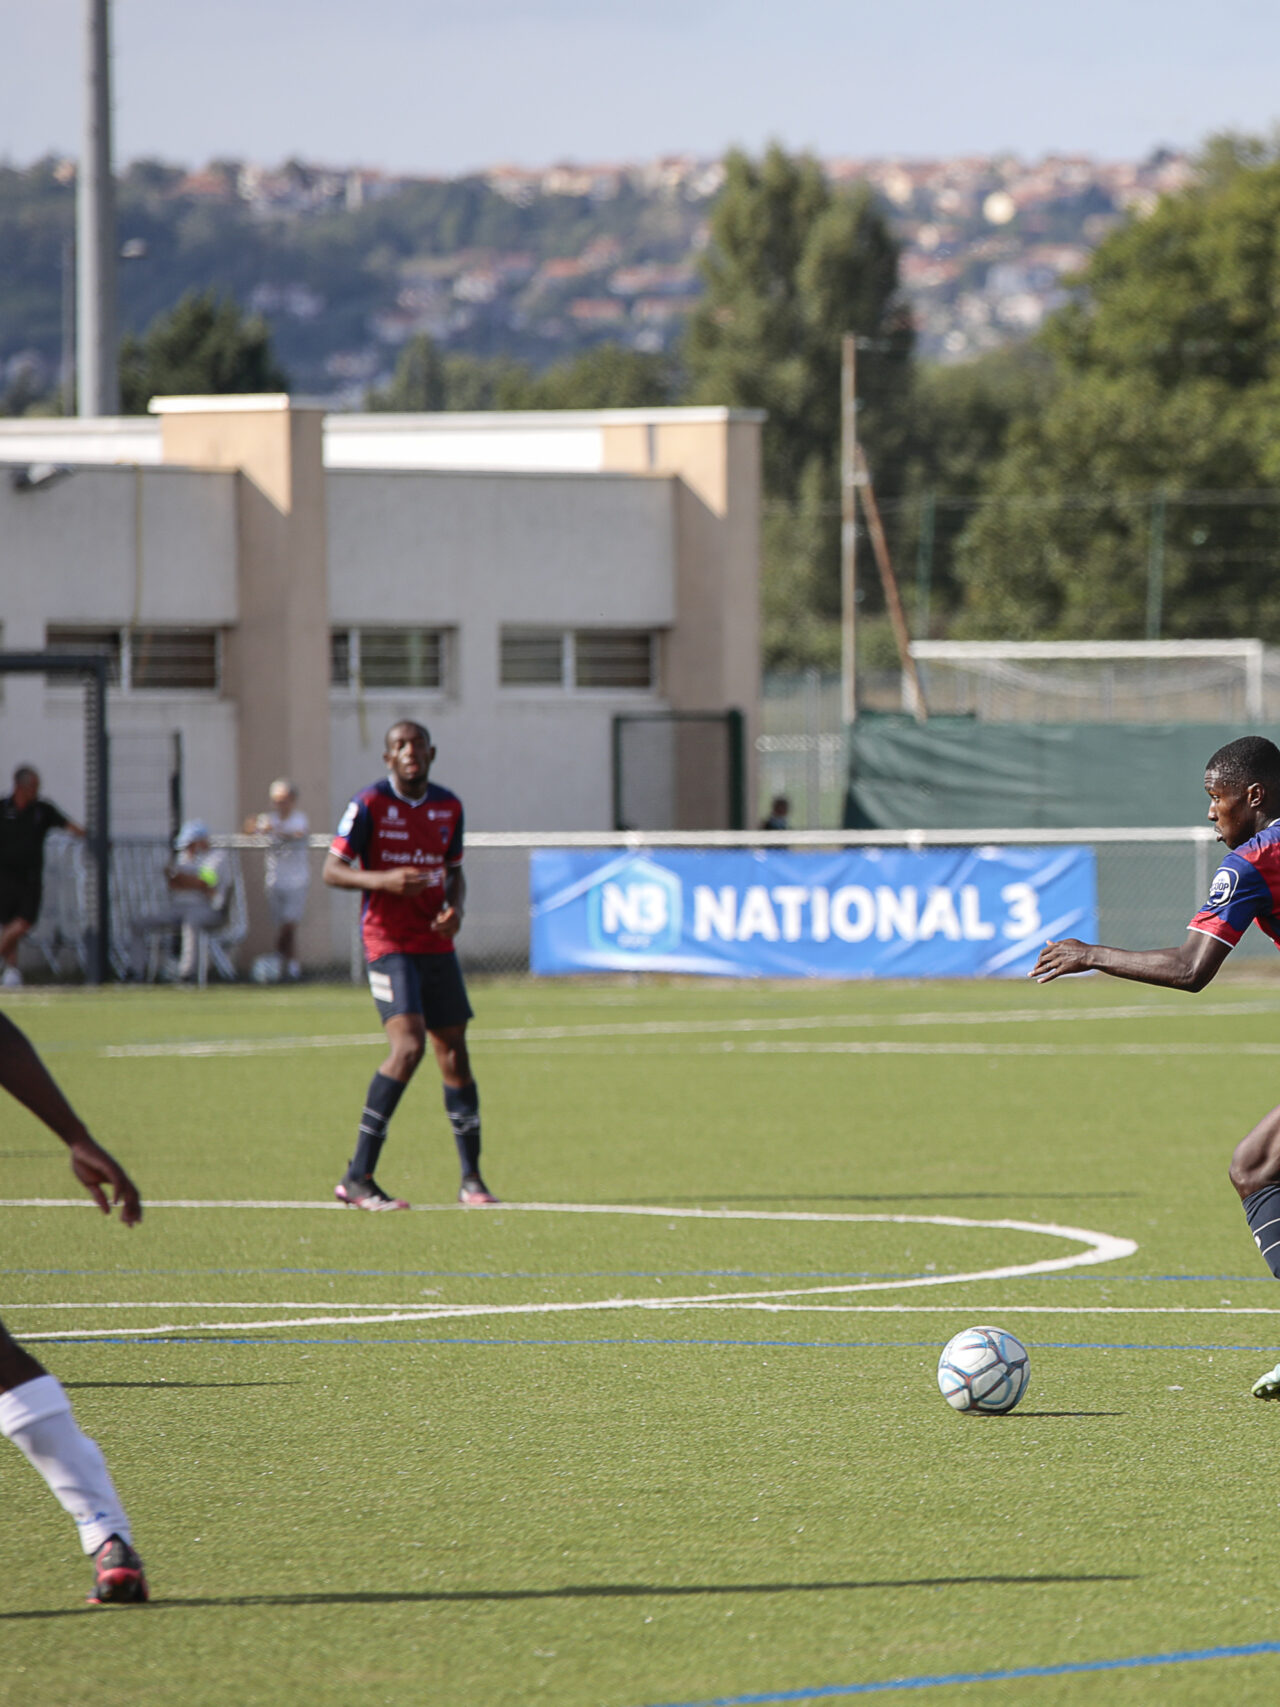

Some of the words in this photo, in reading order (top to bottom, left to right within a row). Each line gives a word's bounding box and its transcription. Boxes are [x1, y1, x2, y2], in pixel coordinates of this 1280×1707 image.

[602, 883, 667, 934] N3
[693, 884, 996, 943] NATIONAL
[1001, 882, 1042, 942] 3
